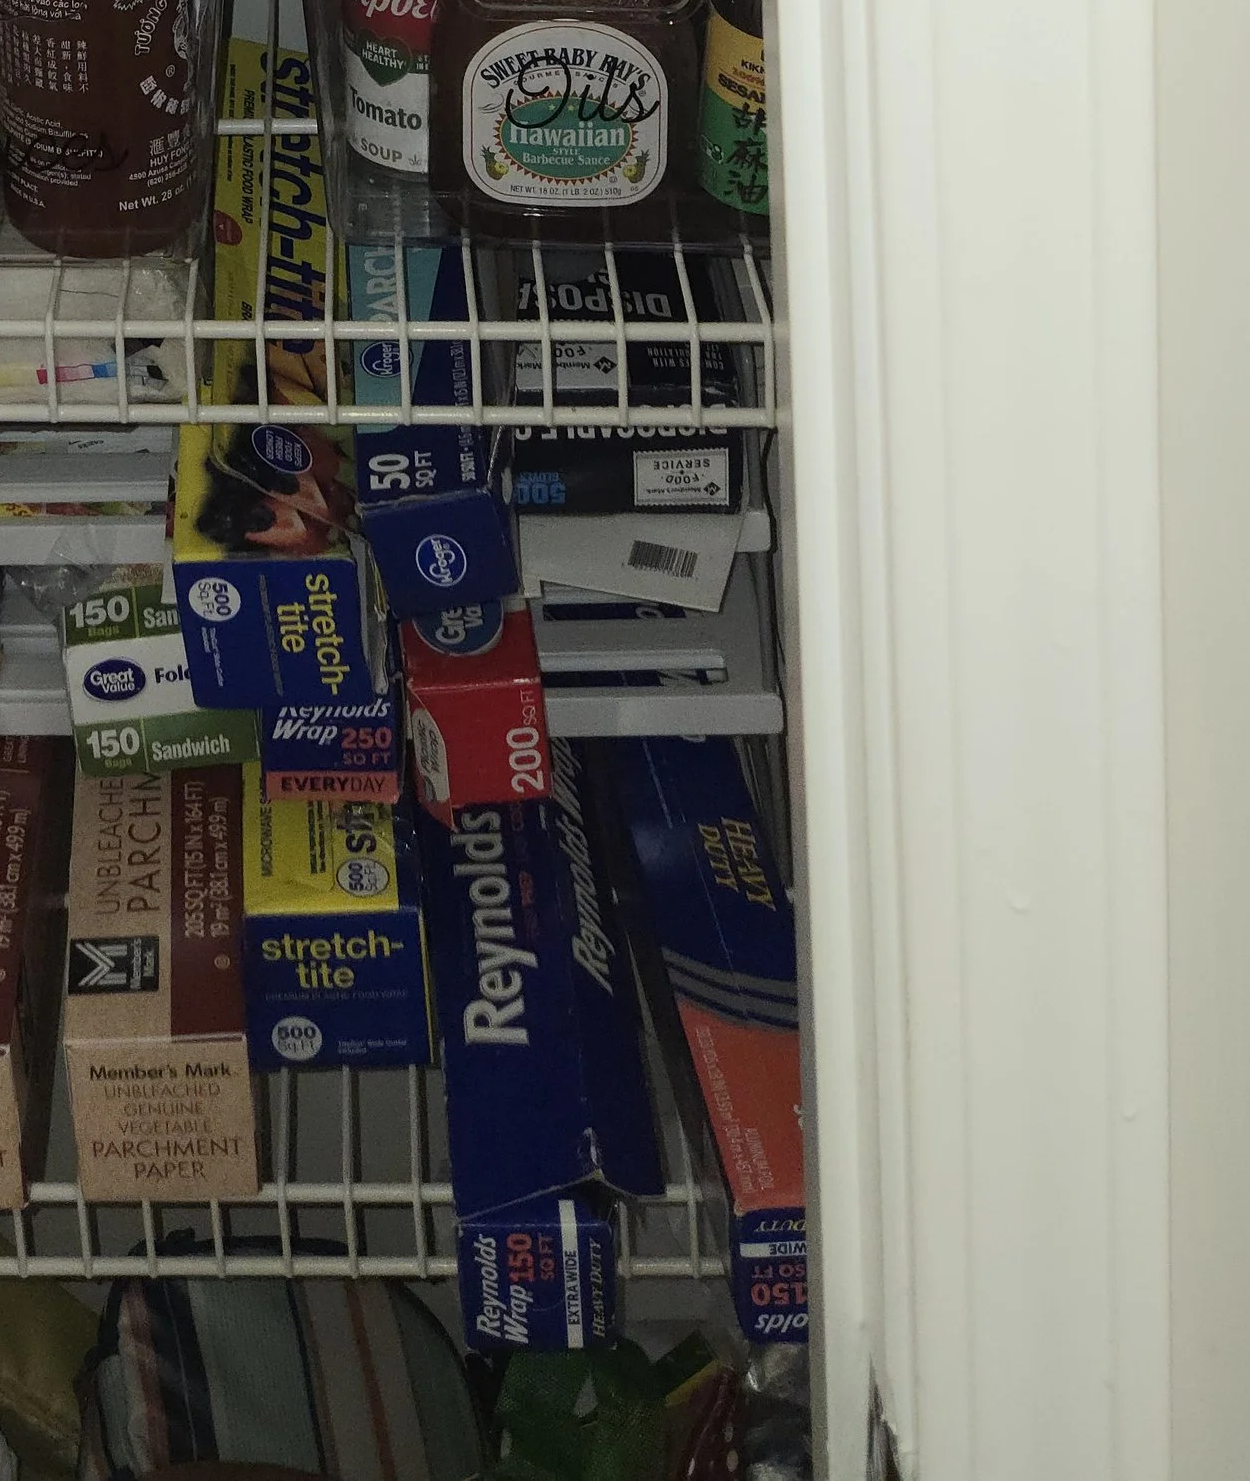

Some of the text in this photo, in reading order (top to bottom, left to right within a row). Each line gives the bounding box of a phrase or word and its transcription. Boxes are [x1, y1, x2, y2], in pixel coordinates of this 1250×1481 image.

[362, 50, 404, 70] HEALTHY
[366, 41, 397, 58] HEART
[480, 50, 539, 89] SWEET
[544, 48, 598, 67] BABY
[505, 55, 661, 128] Oils
[350, 87, 422, 130] Tomato
[509, 120, 625, 147] Hawaiian
[360, 138, 402, 163] SOUP
[523, 152, 610, 165] Barbecue Sauce
[369, 453, 411, 490] 50
[414, 450, 434, 487] SQ FT
[653, 458, 711, 470] SERVICE
[429, 538, 455, 584] Kroger
[69, 596, 130, 629] 150
[212, 583, 232, 616] 500
[277, 602, 309, 653] tite
[305, 573, 351, 695] stretch-
[90, 668, 135, 686] Great
[101, 681, 136, 694] Value
[87, 727, 230, 762] 150 Sandwich
[272, 718, 392, 748] Wrap 250
[507, 726, 544, 794] 200
[281, 777, 386, 793] EVERYDAY
[555, 813, 616, 997] Reynolds
[450, 812, 538, 1045] Reynolds
[262, 930, 404, 961] stretch-
[296, 962, 355, 988] tite
[277, 1026, 316, 1039] 500
[89, 1064, 232, 1081] Member's Mark
[93, 1137, 243, 1159] PARCHMENT
[135, 1161, 206, 1180] PAPER
[474, 1234, 507, 1338] Reynolds
[503, 1233, 534, 1344] Wrap 150
[564, 1250, 580, 1325] EXTRA WIDE
